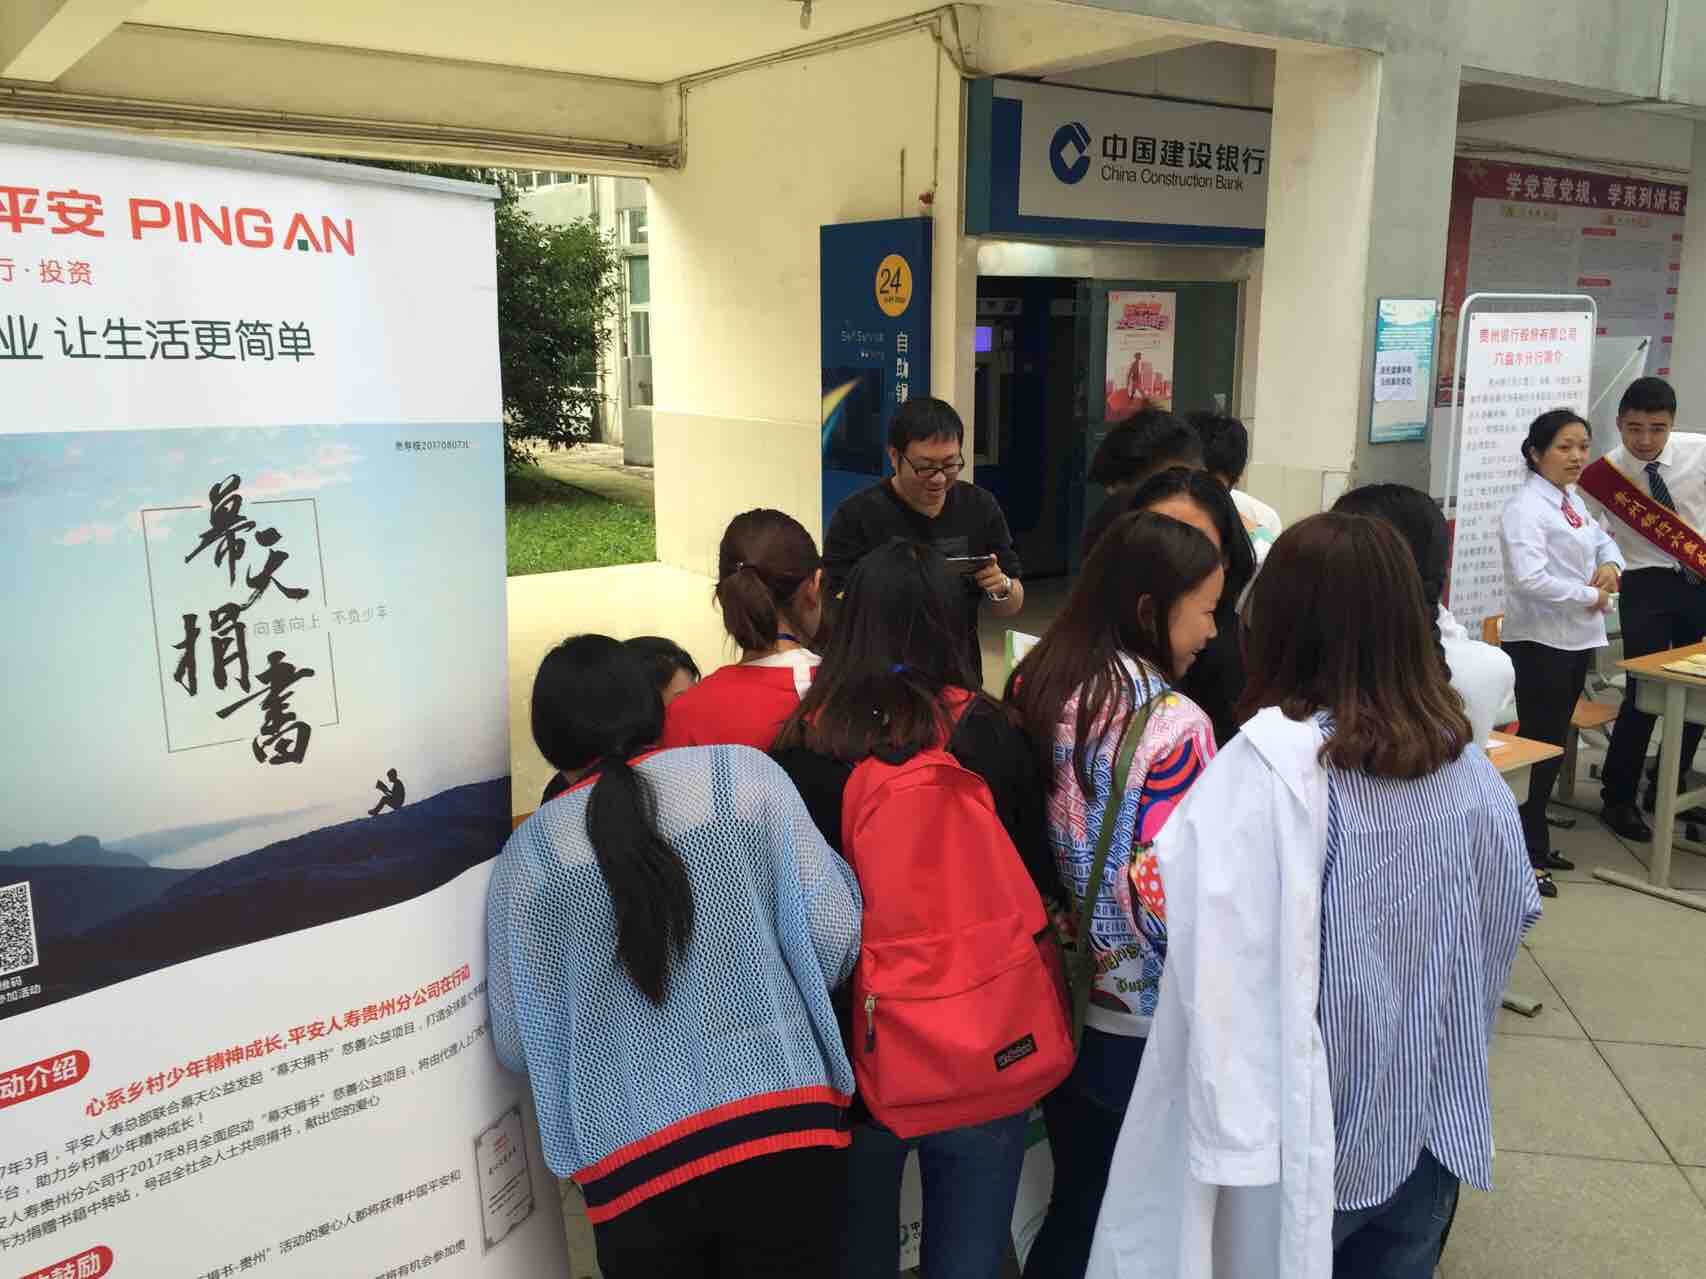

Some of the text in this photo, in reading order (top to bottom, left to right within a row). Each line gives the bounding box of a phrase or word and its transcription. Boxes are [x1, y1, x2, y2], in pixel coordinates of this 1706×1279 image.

[1102, 133, 1266, 175] 中国建设银行
[1101, 164, 1244, 191] China Construction Bank
[0, 185, 105, 239] 平安
[879, 266, 903, 294] 24
[54, 315, 316, 362] 让生活更简单
